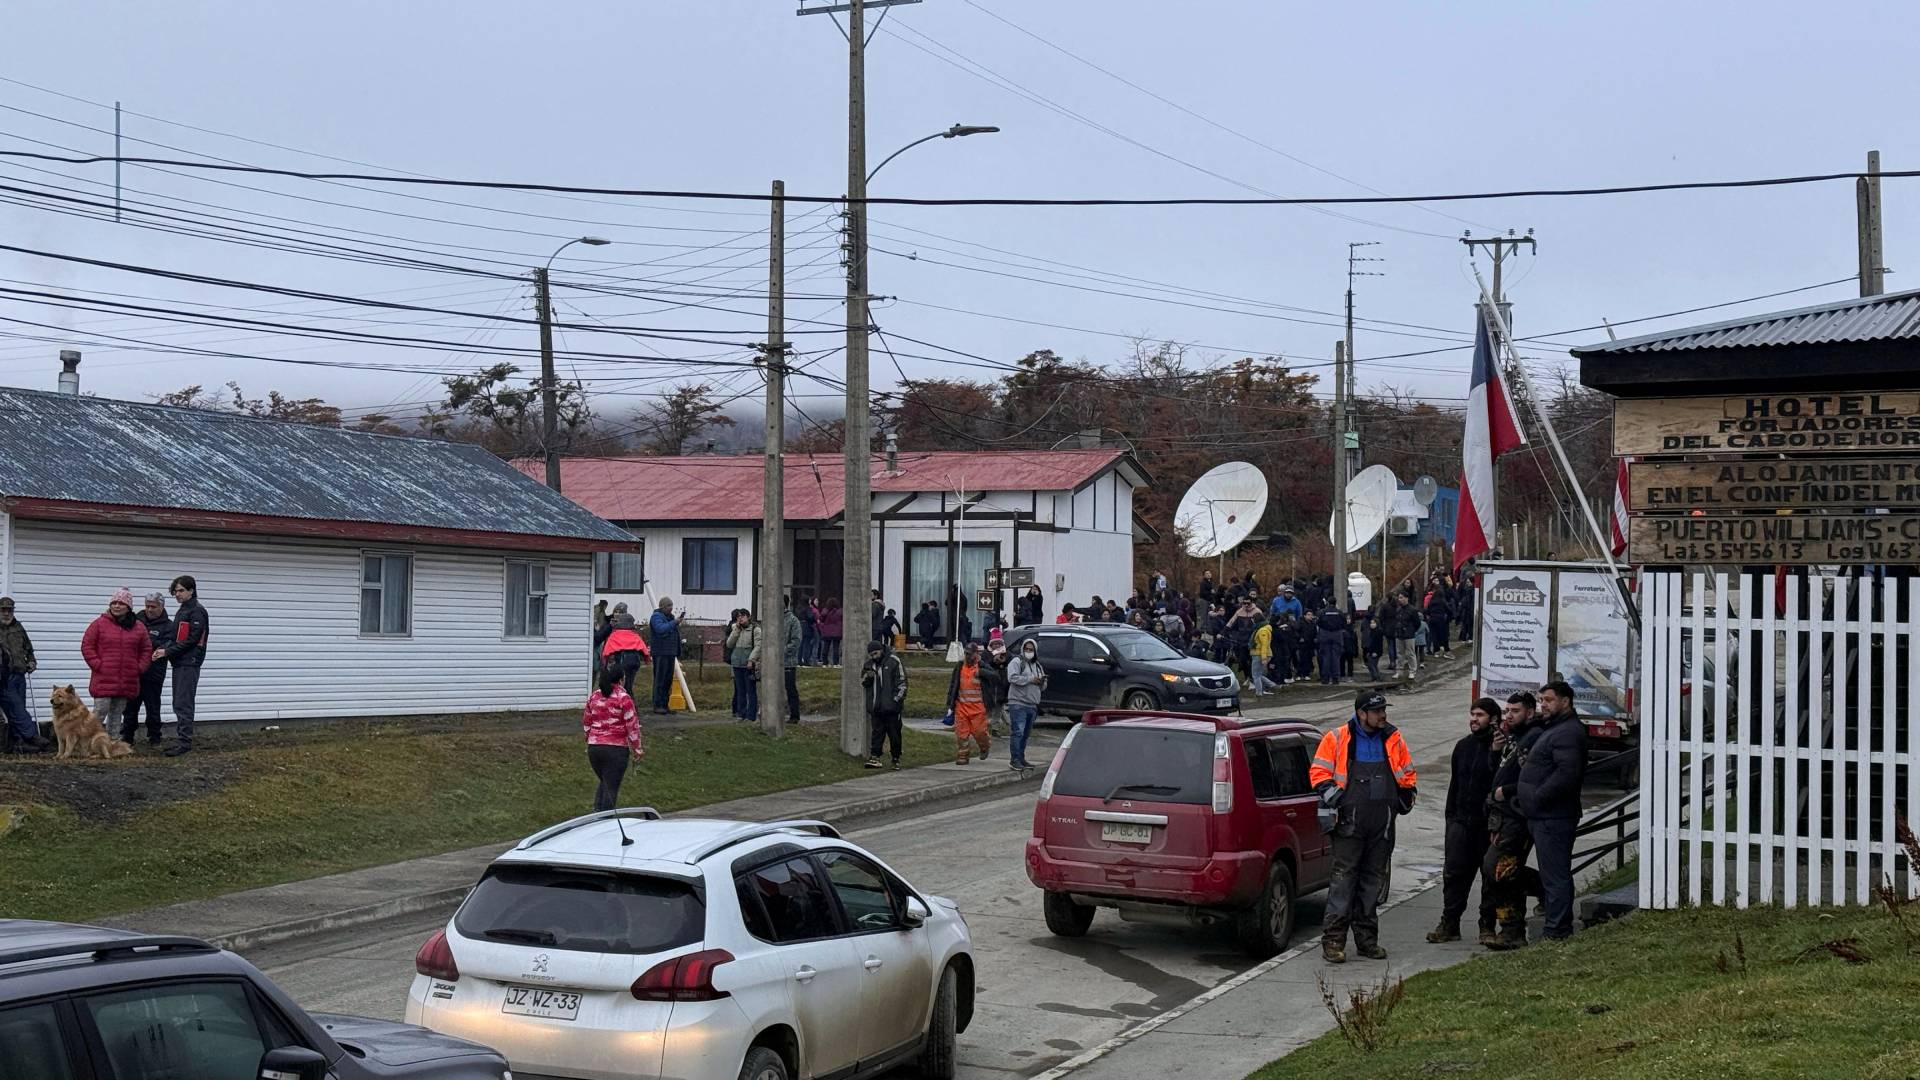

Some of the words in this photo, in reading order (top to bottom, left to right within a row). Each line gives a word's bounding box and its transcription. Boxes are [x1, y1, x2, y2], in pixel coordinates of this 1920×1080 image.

[1746, 396, 1896, 417] HOTEL
[1719, 417, 1920, 433] FORJADORES
[1663, 435, 1721, 449] DEL
[1727, 433, 1806, 448] CABO
[1812, 432, 1852, 447] DE
[1647, 487, 1681, 504] EN
[1687, 486, 1721, 503] EL
[1727, 482, 1828, 502] CONFÍN
[1834, 485, 1889, 502] DEL
[1655, 519, 1757, 542] PUERTO
[1762, 518, 1881, 541] WILLIAMS
